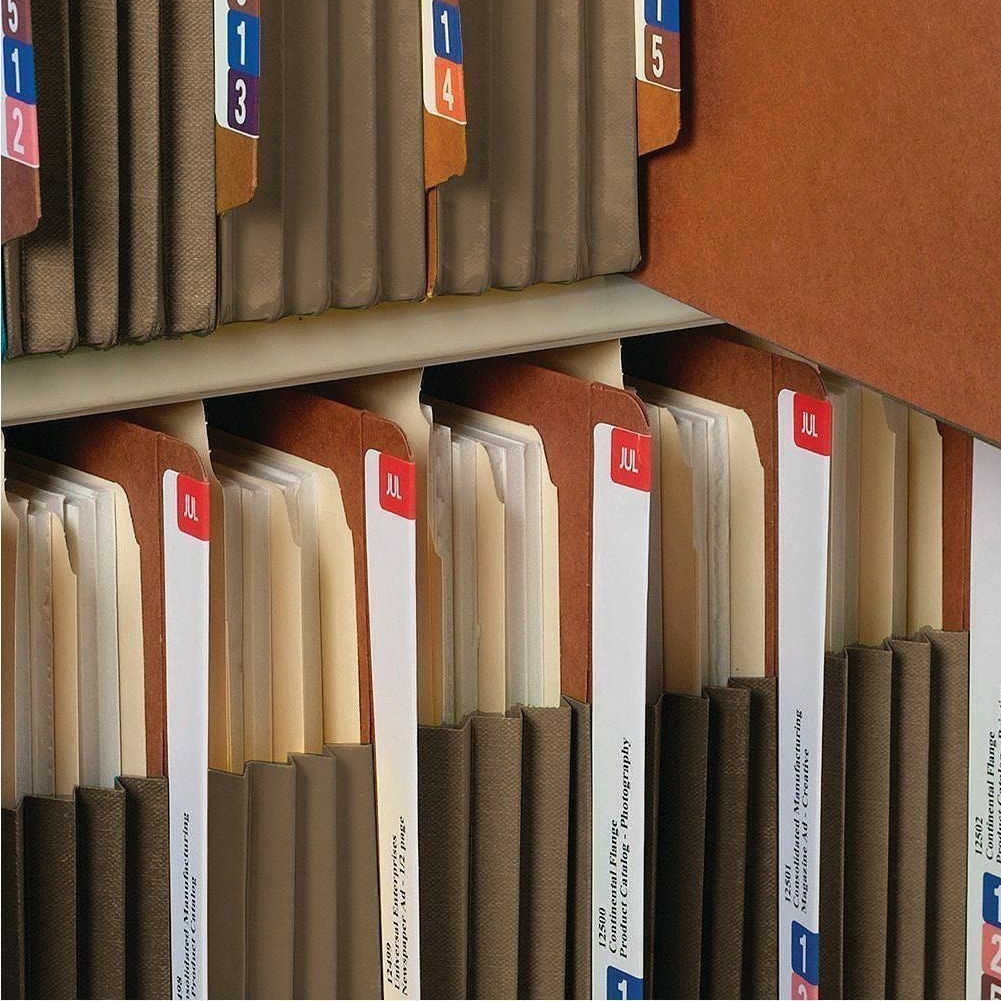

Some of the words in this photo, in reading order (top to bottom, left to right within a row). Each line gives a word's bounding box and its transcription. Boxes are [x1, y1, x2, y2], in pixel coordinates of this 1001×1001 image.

[800, 411, 819, 438] JUL
[386, 473, 403, 501] JUL
[619, 447, 640, 474] JUL
[184, 495, 199, 522] JUL
[793, 709, 802, 815] Manufacturing
[801, 749, 809, 809] Creative
[987, 731, 996, 777] Flange
[620, 737, 631, 830] Photography
[609, 819, 618, 868] Flange
[801, 821, 808, 843] Ad
[986, 780, 994, 860] Continental
[182, 812, 190, 922] Manufacturing
[620, 843, 629, 898] Catalog
[800, 846, 809, 913] Magazine
[598, 907, 606, 948] 12500
[609, 870, 617, 954] Continental
[619, 901, 628, 959] Product
